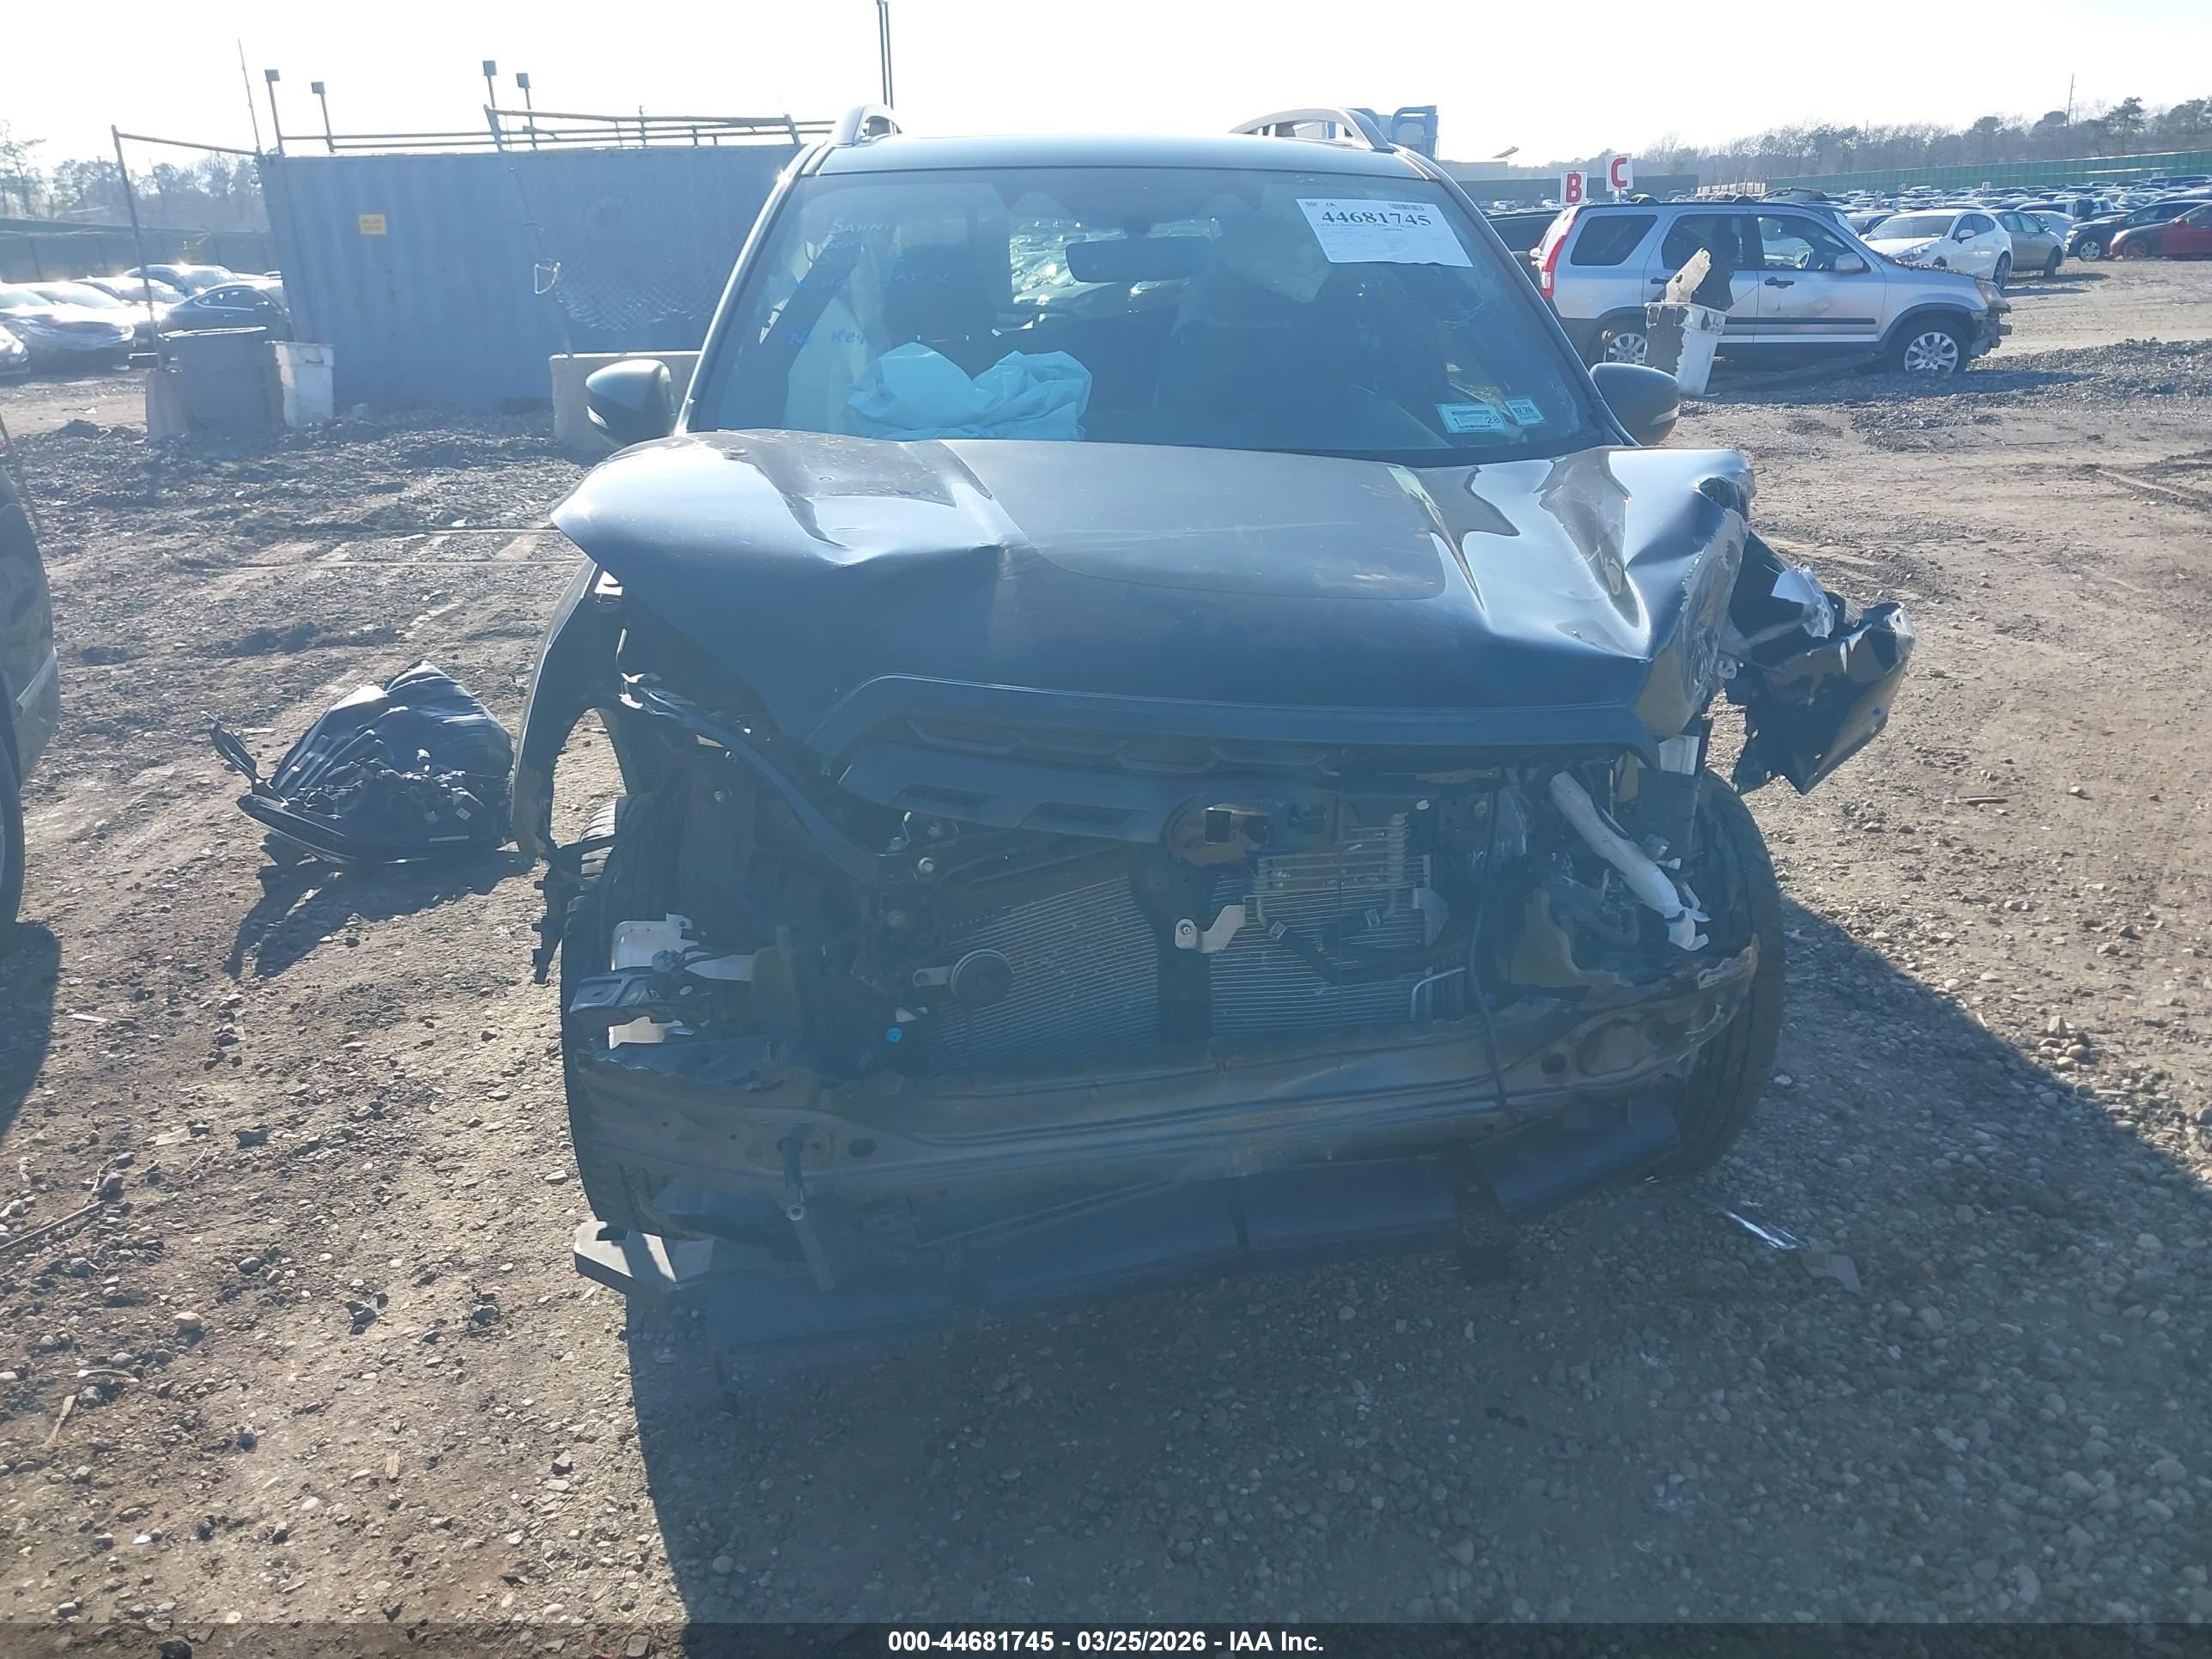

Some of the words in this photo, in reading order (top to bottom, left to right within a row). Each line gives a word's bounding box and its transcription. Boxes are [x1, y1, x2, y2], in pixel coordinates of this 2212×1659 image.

[1610, 156, 1628, 188] C
[1565, 173, 1583, 204] B
[1322, 210, 1431, 227] 44681745
